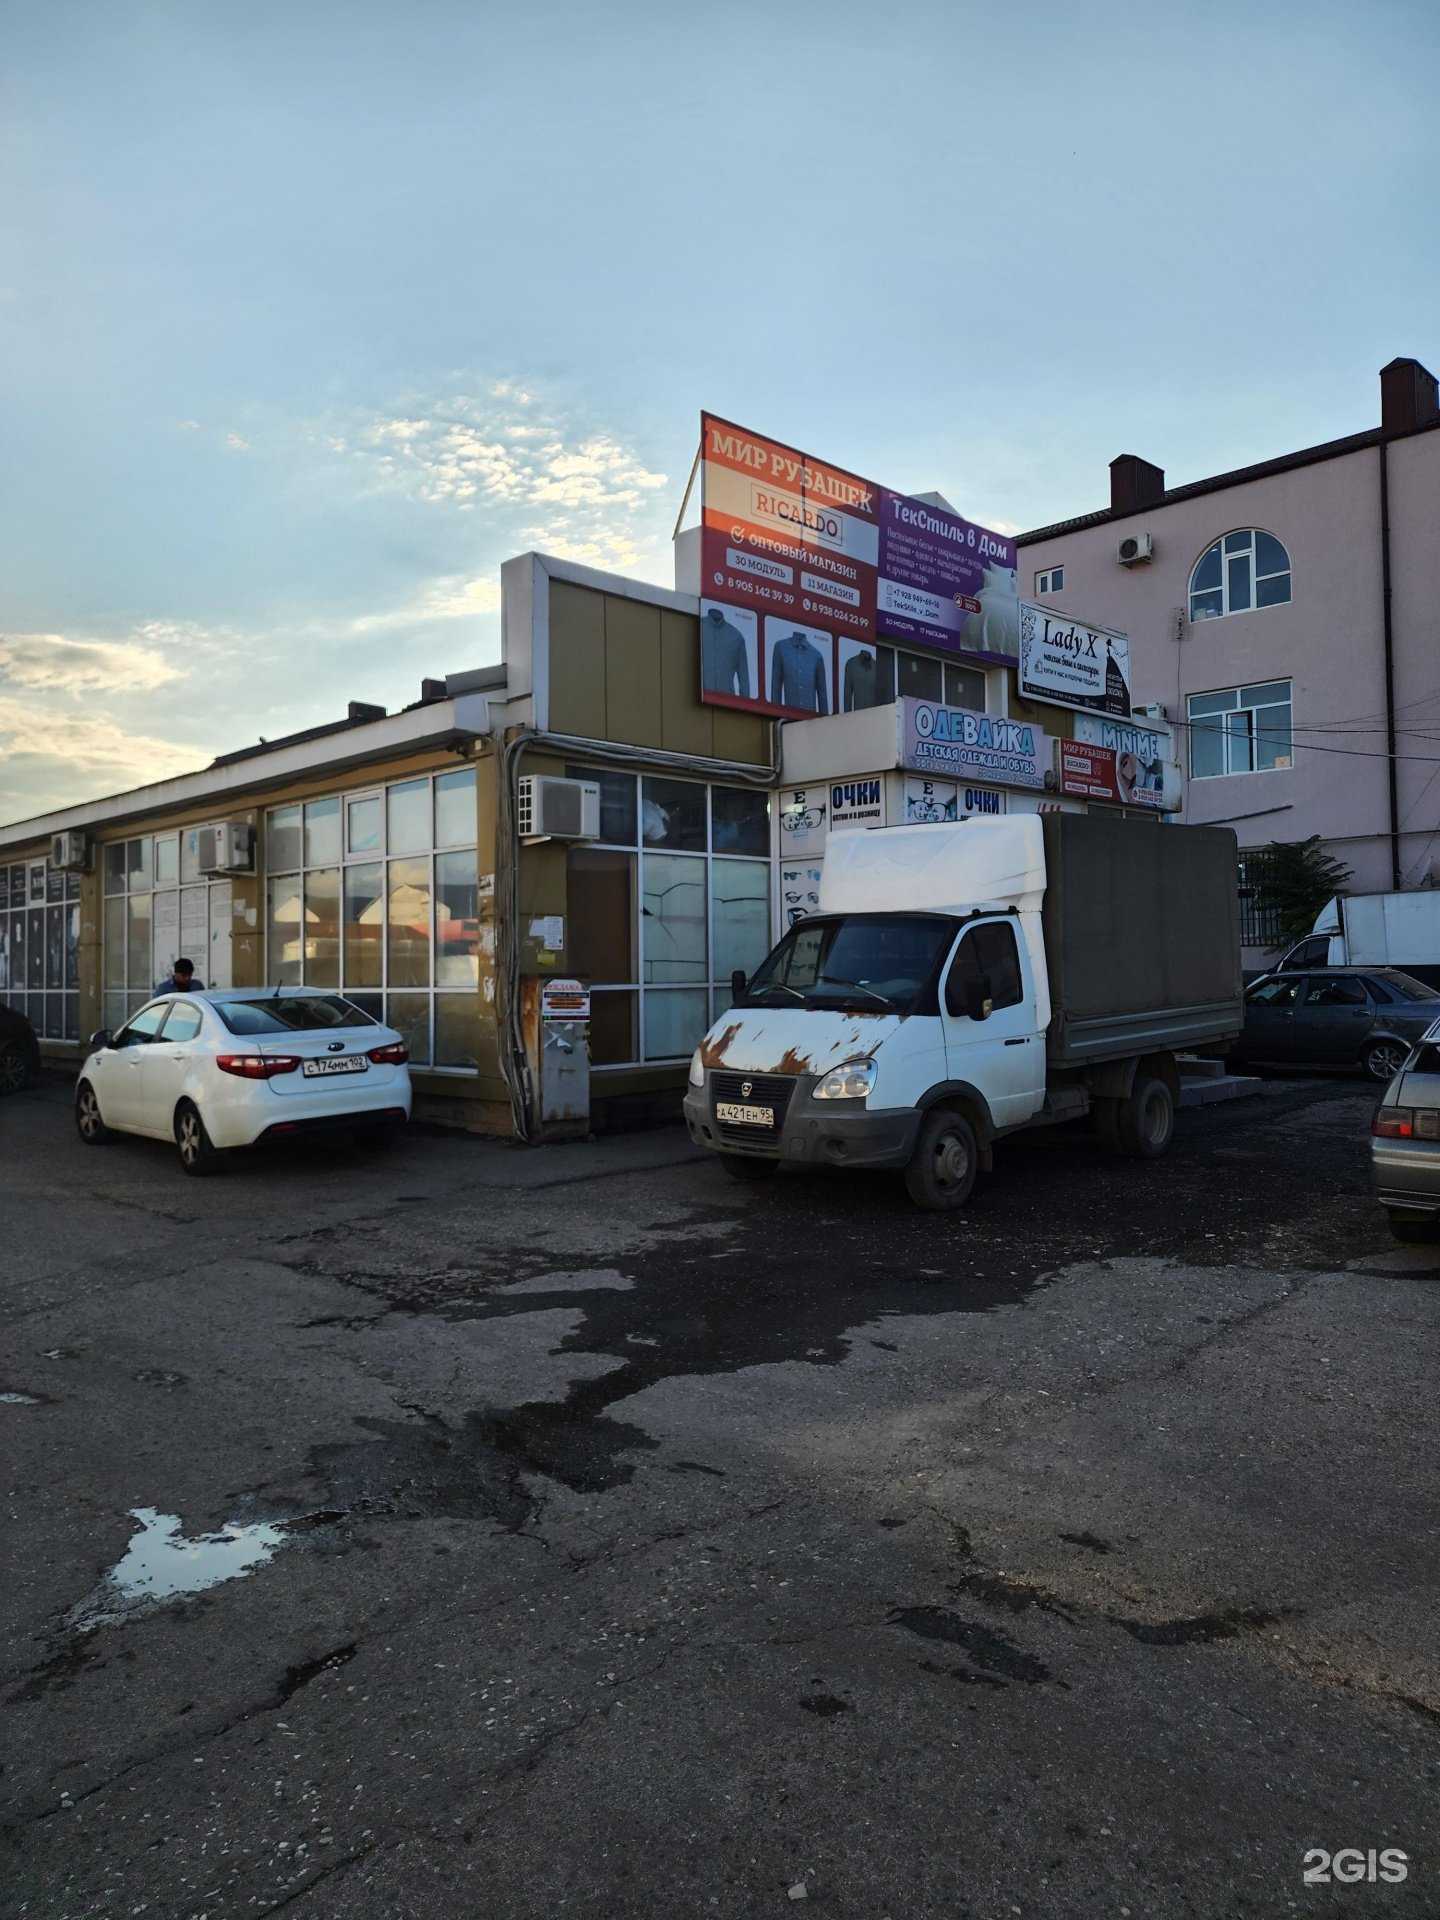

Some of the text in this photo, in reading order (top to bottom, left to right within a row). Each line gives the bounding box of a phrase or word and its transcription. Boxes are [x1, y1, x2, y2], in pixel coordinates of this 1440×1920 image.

[712, 430, 874, 515] МИР РУБАШЕК
[756, 491, 838, 538] RICARDO
[748, 534, 808, 562] ОПТОВЫЙ
[809, 553, 858, 580] МАГАЗИН
[967, 529, 976, 548] в
[978, 534, 1009, 561] Дом
[735, 555, 787, 579] 30 МОДУЛЬ
[728, 576, 735, 588] 8
[735, 579, 754, 593] 905
[755, 584, 771, 598] 142
[784, 593, 795, 605] 39
[816, 580, 854, 601] МАГАЗИН
[811, 603, 818, 613] 8
[819, 605, 834, 618] 938
[860, 618, 870, 628] 99
[915, 704, 1036, 757] ОДЕВАЙКА
[916, 741, 960, 763] ДЕТСКАЯ
[960, 749, 1000, 769] ОДЕЖДА
[999, 756, 1008, 769] И
[1008, 758, 1036, 775] ОБУВЬ
[1063, 742, 1079, 754] МИР
[832, 780, 881, 809] ОЧКИ
[965, 788, 1000, 814] ОЧКИ
